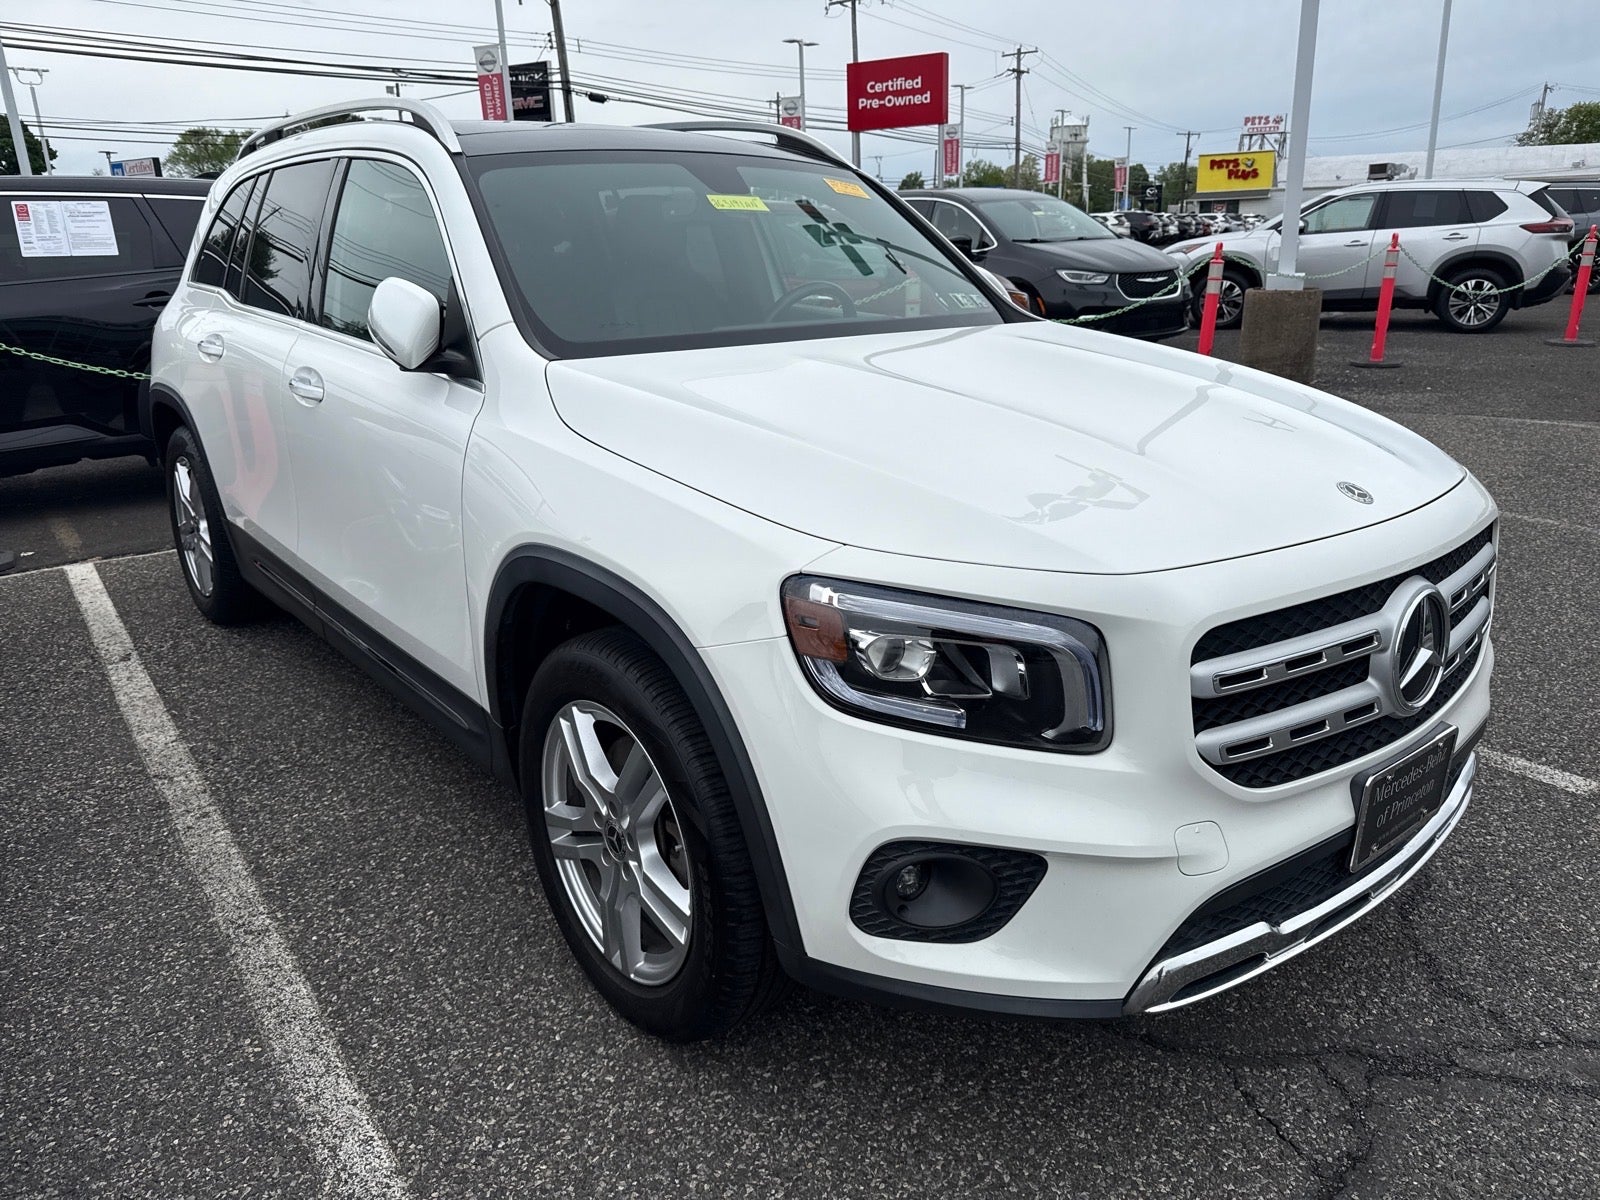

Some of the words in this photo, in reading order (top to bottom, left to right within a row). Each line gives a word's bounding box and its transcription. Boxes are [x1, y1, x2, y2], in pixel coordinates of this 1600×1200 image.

[508, 72, 544, 82] UICK
[866, 76, 922, 93] Certified
[858, 91, 931, 110] Pre-Owned
[1244, 115, 1271, 126] PETS
[125, 160, 153, 175] Certified
[1209, 158, 1241, 170] PETS
[1227, 168, 1259, 180] PLUS
[1373, 748, 1447, 805] Mercedes-Benz
[1376, 805, 1391, 828] of
[1390, 779, 1435, 819] Princeton
